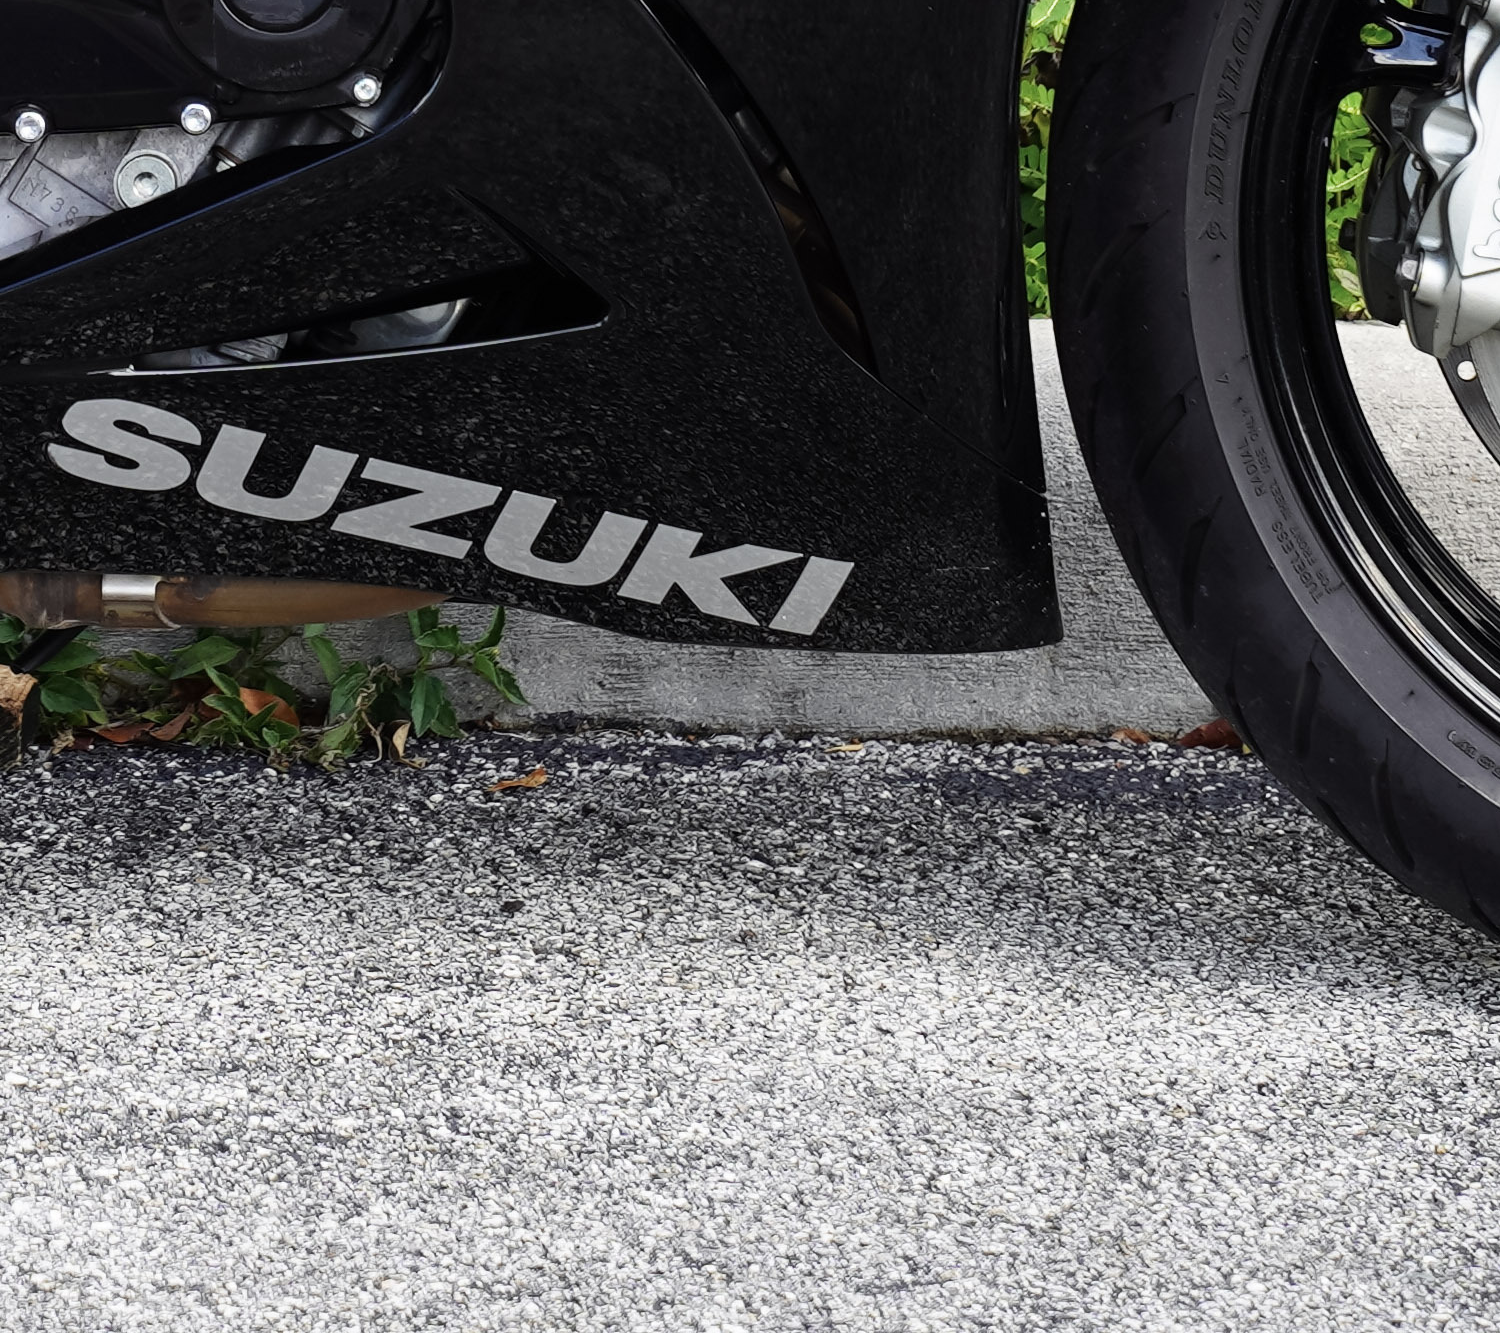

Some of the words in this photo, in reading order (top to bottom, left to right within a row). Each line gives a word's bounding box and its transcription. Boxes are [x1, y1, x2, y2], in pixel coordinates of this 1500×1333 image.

[1233, 435, 1269, 498] RADIAL
[46, 398, 856, 636] SUZUKI
[1268, 519, 1327, 605] TUBELESS
